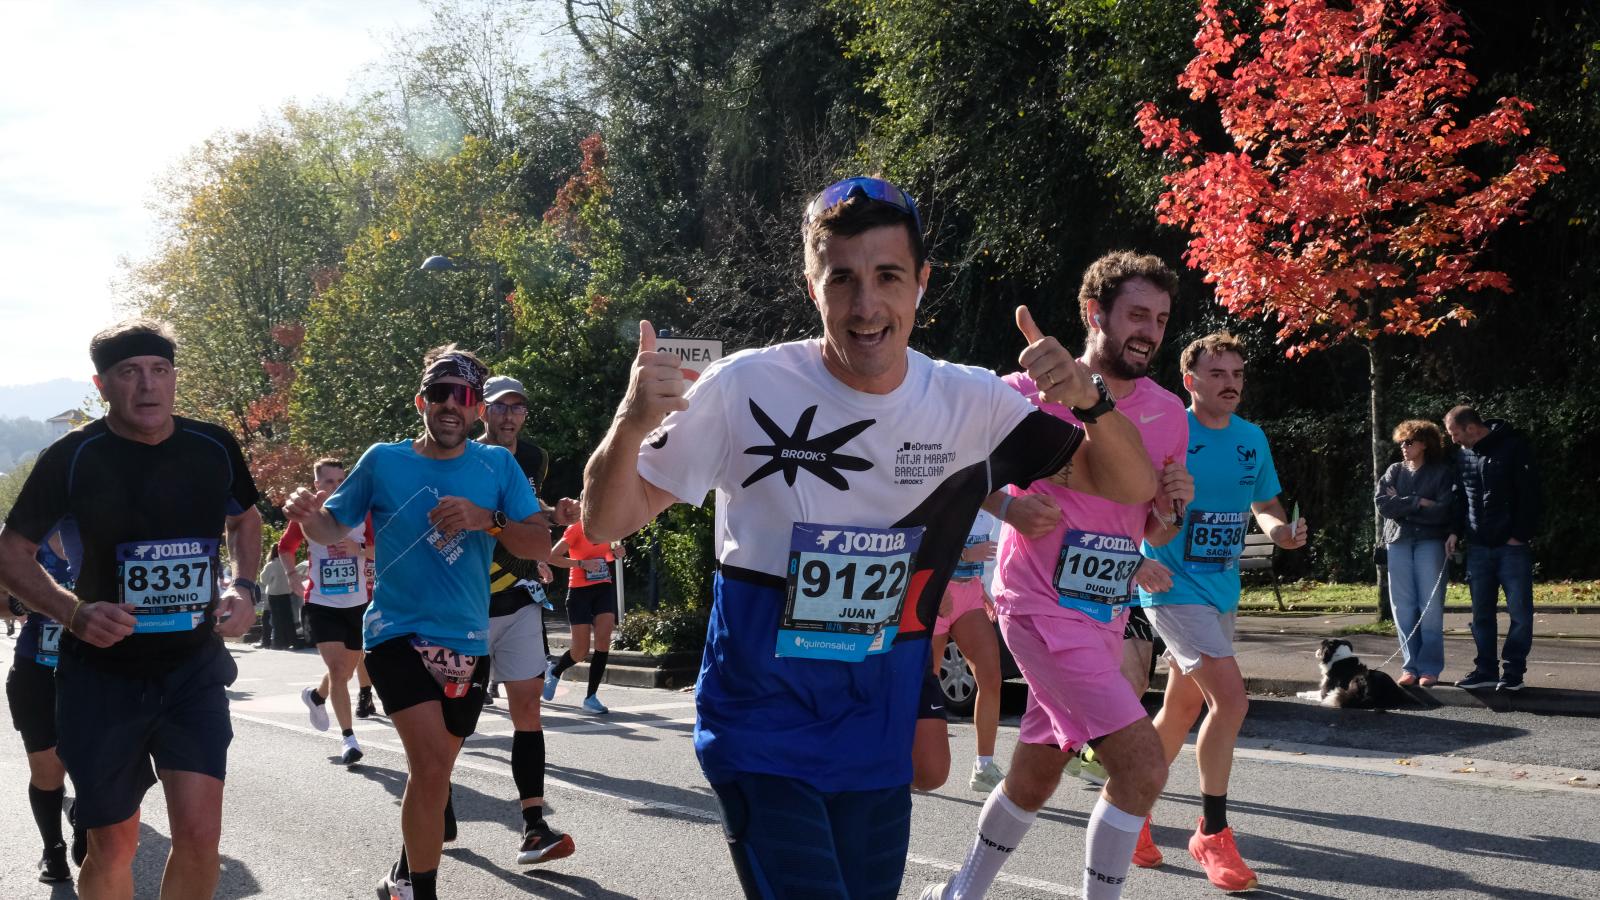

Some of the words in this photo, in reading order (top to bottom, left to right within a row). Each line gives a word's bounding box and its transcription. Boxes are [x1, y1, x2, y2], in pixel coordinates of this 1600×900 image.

[911, 442, 942, 451] eDreams
[781, 448, 827, 462] BROOKS
[895, 454, 921, 465] MITJA
[894, 466, 945, 478] BARCELONA
[426, 530, 442, 545] 10K
[445, 545, 464, 566] 2014
[1206, 548, 1232, 557] SACHA
[324, 566, 356, 578] 9133
[1068, 553, 1137, 582] 10283
[127, 561, 208, 592] 8337
[801, 559, 907, 601] 9122
[142, 592, 199, 605] ANTONIO
[838, 607, 876, 620] JUAN
